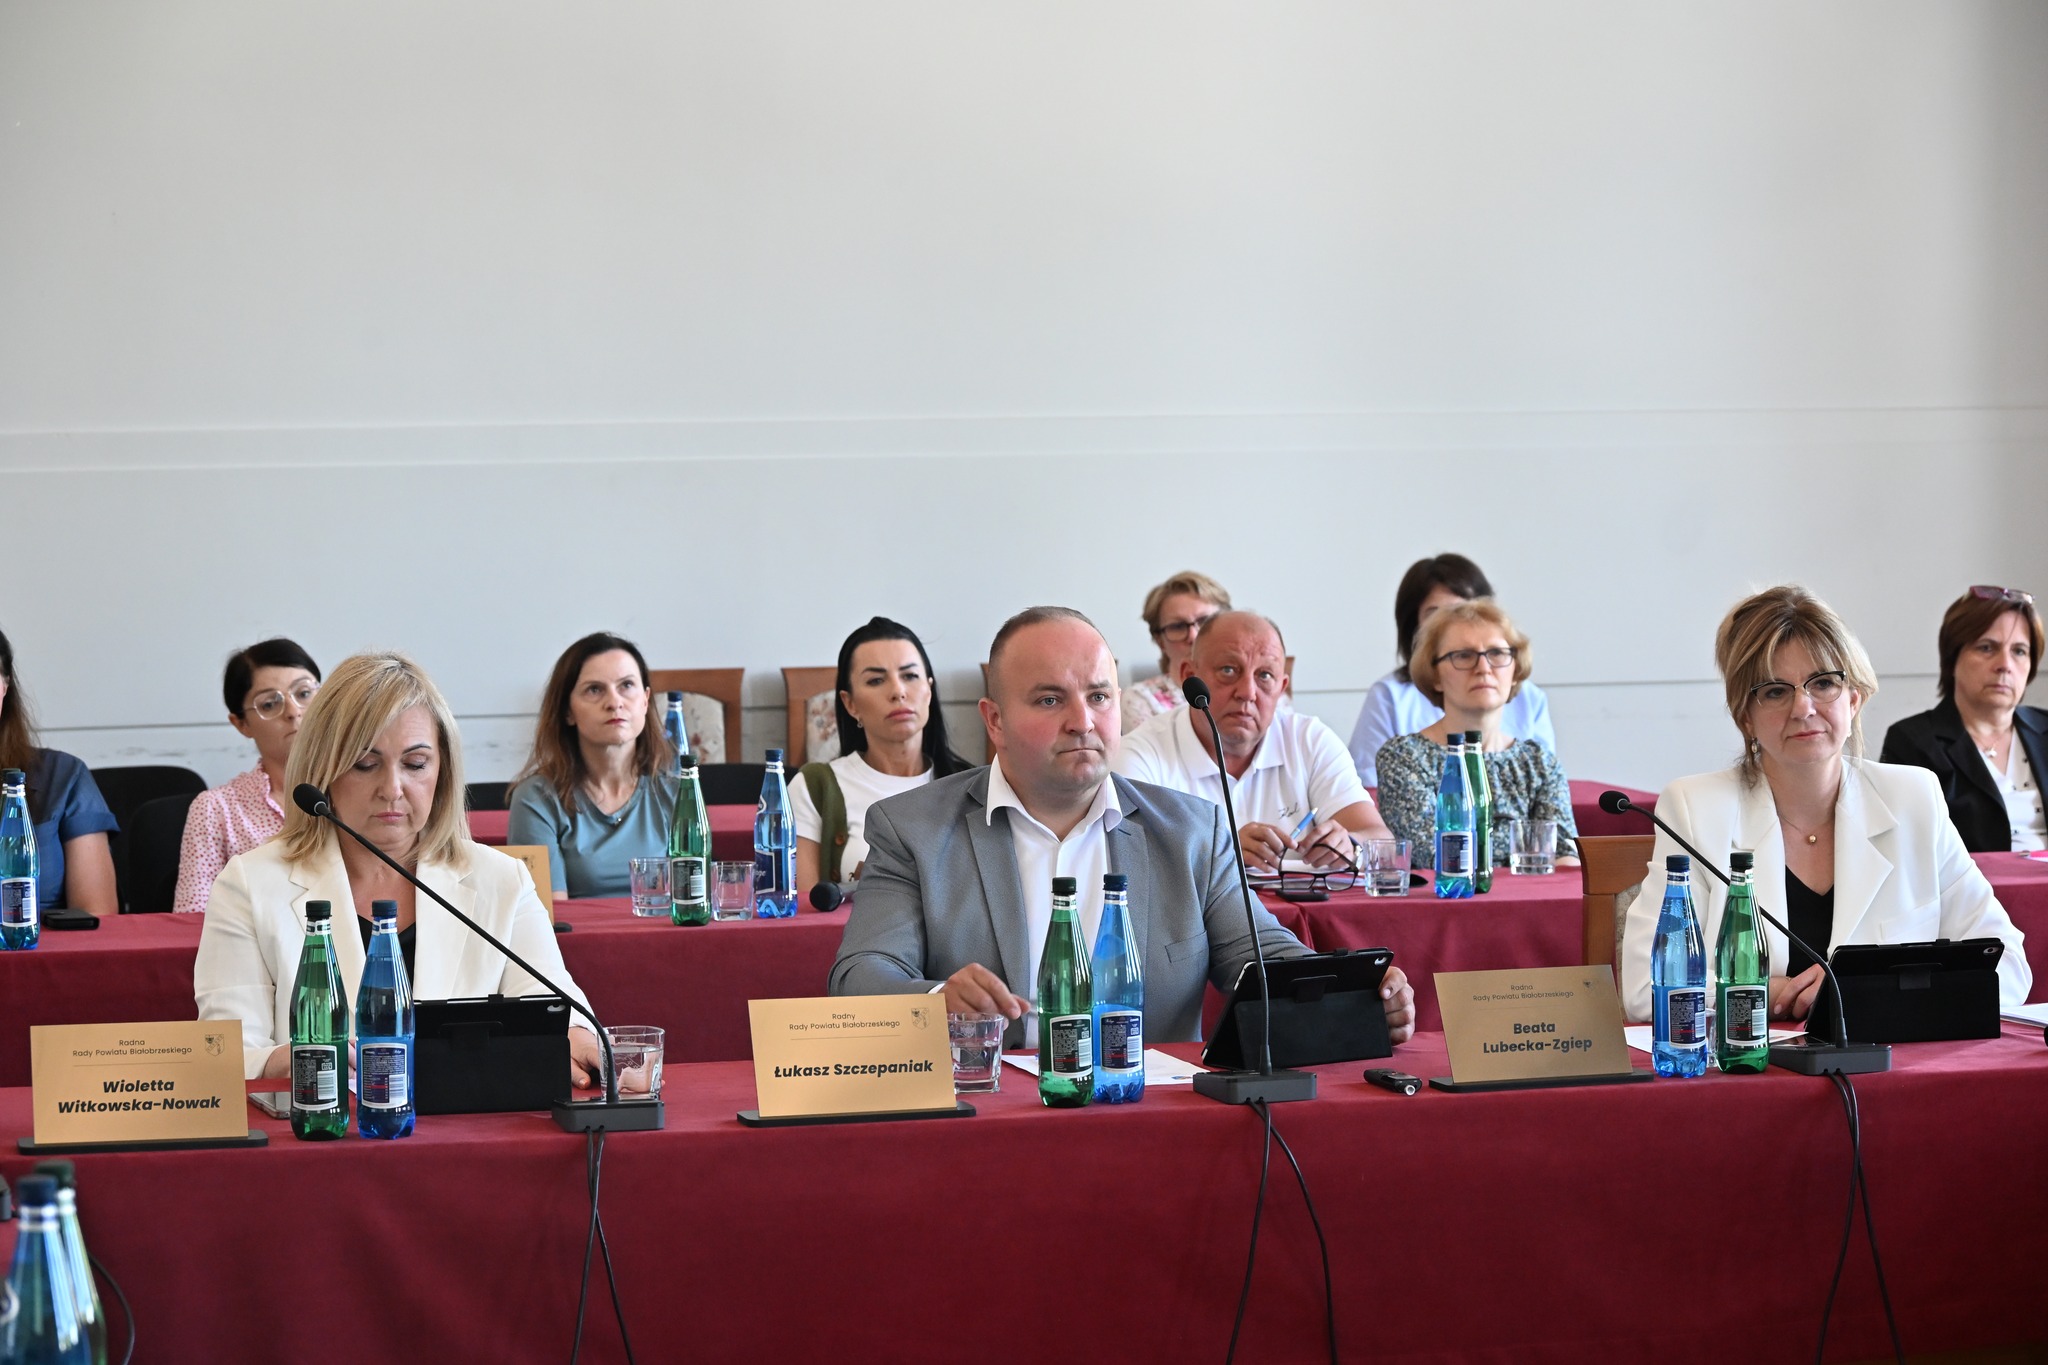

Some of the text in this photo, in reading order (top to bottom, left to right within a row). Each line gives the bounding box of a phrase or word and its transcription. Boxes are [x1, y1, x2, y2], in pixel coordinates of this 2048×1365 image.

[1521, 991, 1574, 999] Białobrzeskiego
[832, 1013, 855, 1021] Radny
[789, 1020, 900, 1032] Rady Powiatu Białobrzeskiego
[1513, 1022, 1555, 1034] Beata
[1483, 1037, 1593, 1053] Lubecka-Zgiep
[73, 1047, 192, 1058] Rady Powiatu Białobrzeskiego
[774, 1060, 933, 1078] Łukasz Szczepaniak
[103, 1079, 174, 1093] Wioletta
[58, 1096, 221, 1113] Witkowska-Nowak
